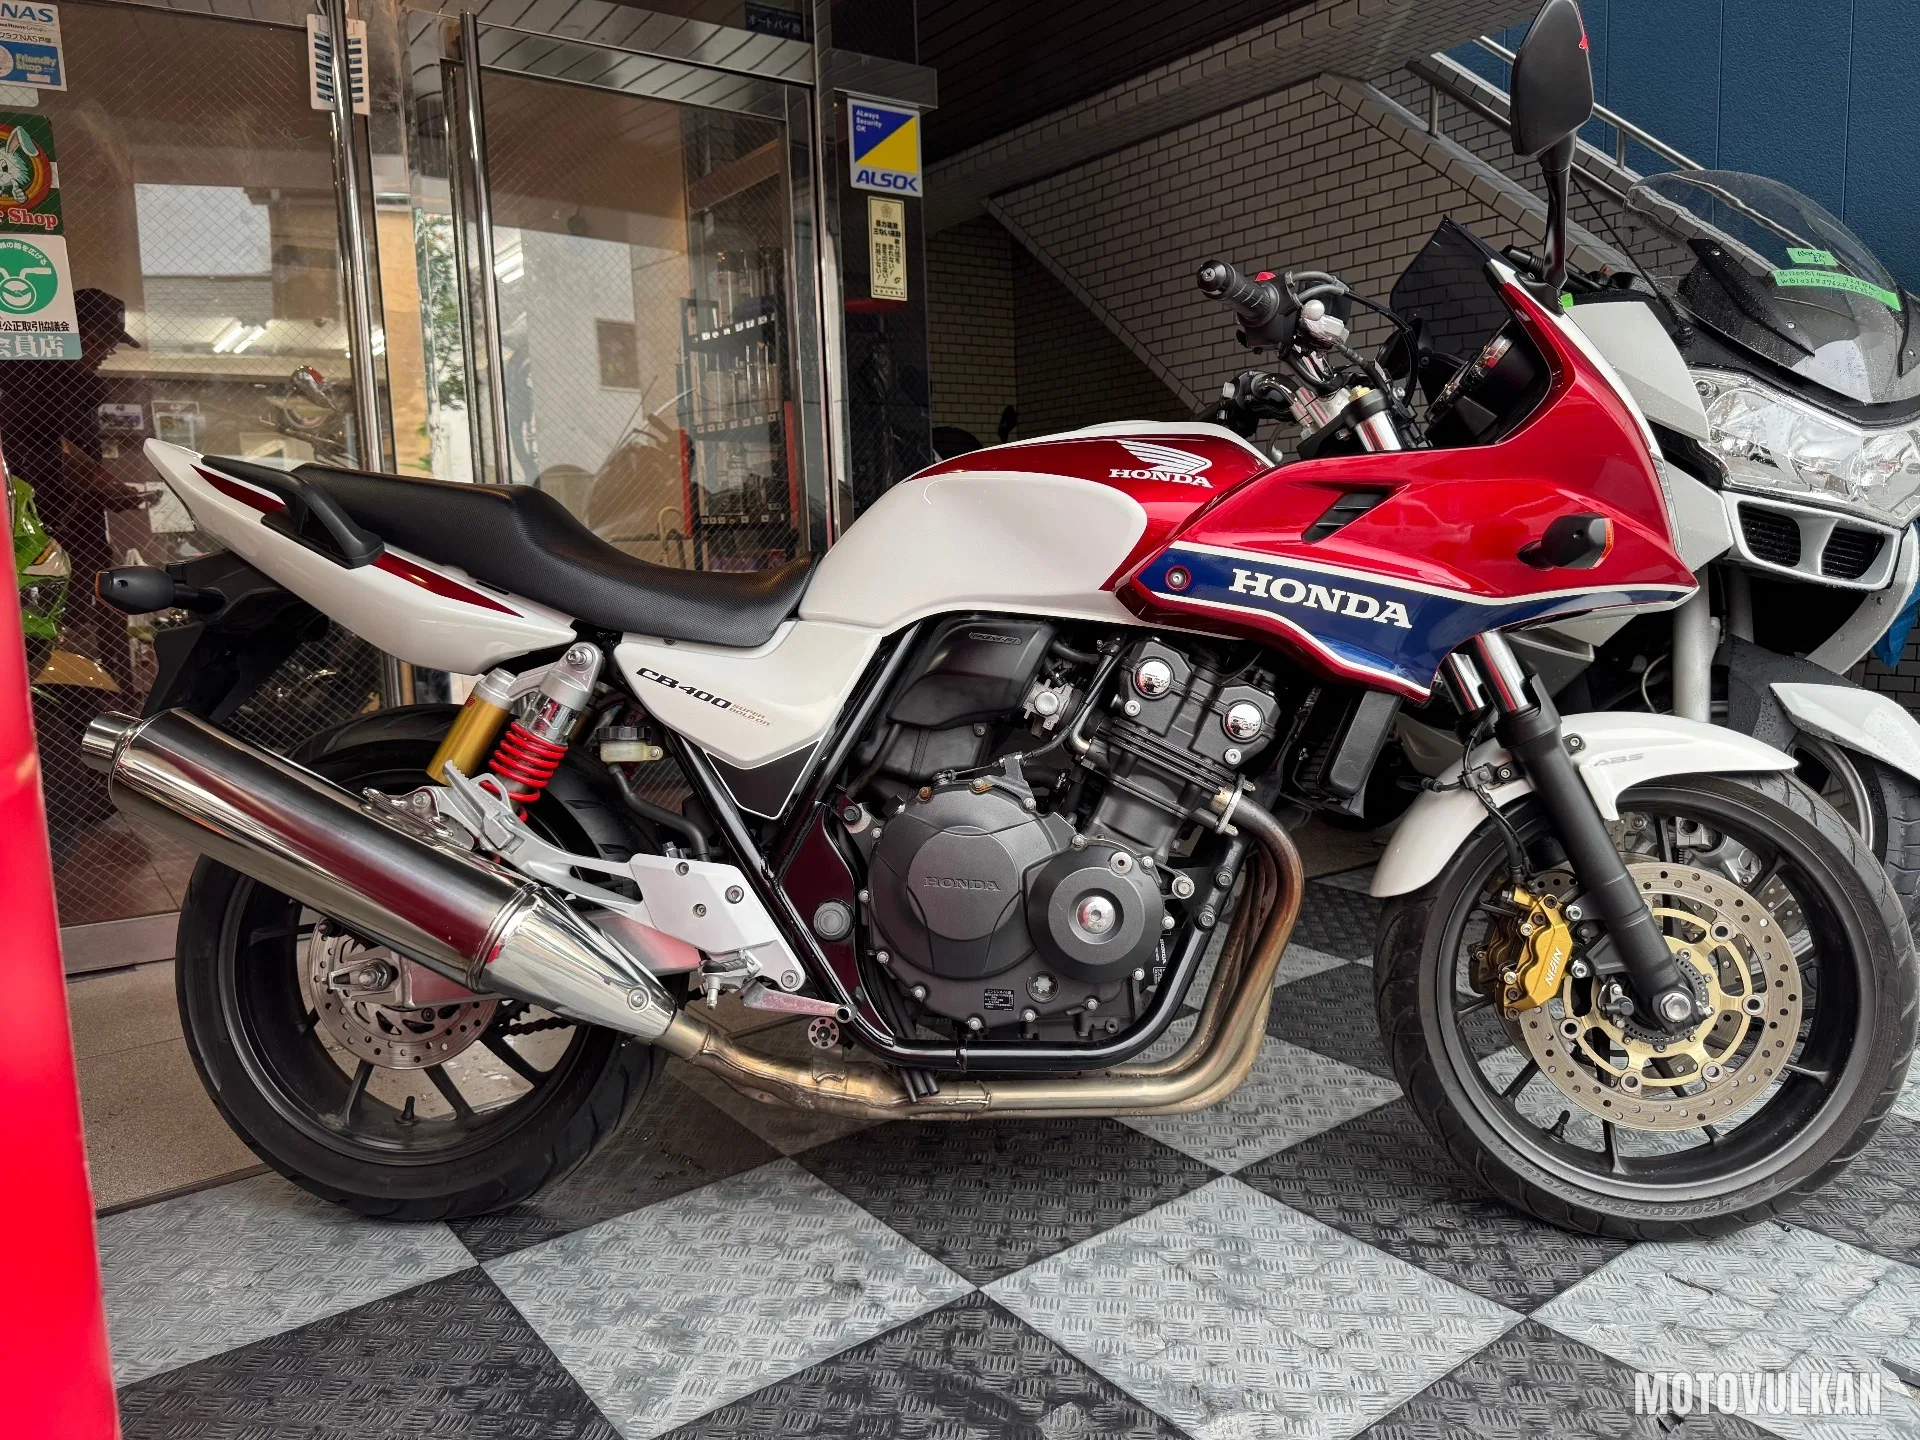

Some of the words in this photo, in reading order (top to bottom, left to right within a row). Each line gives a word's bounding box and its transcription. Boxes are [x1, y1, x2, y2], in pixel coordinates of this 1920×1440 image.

[1, 3, 54, 23] NAS
[16, 62, 43, 73] Shop
[856, 117, 882, 128] Security
[856, 169, 918, 192] ALSOK
[8, 207, 58, 230] Shop
[1108, 468, 1214, 489] HONDA
[1228, 568, 1413, 629] HONDA
[635, 667, 733, 709] CB400
[732, 704, 766, 719] SUPER
[924, 876, 1002, 892] HONDA
